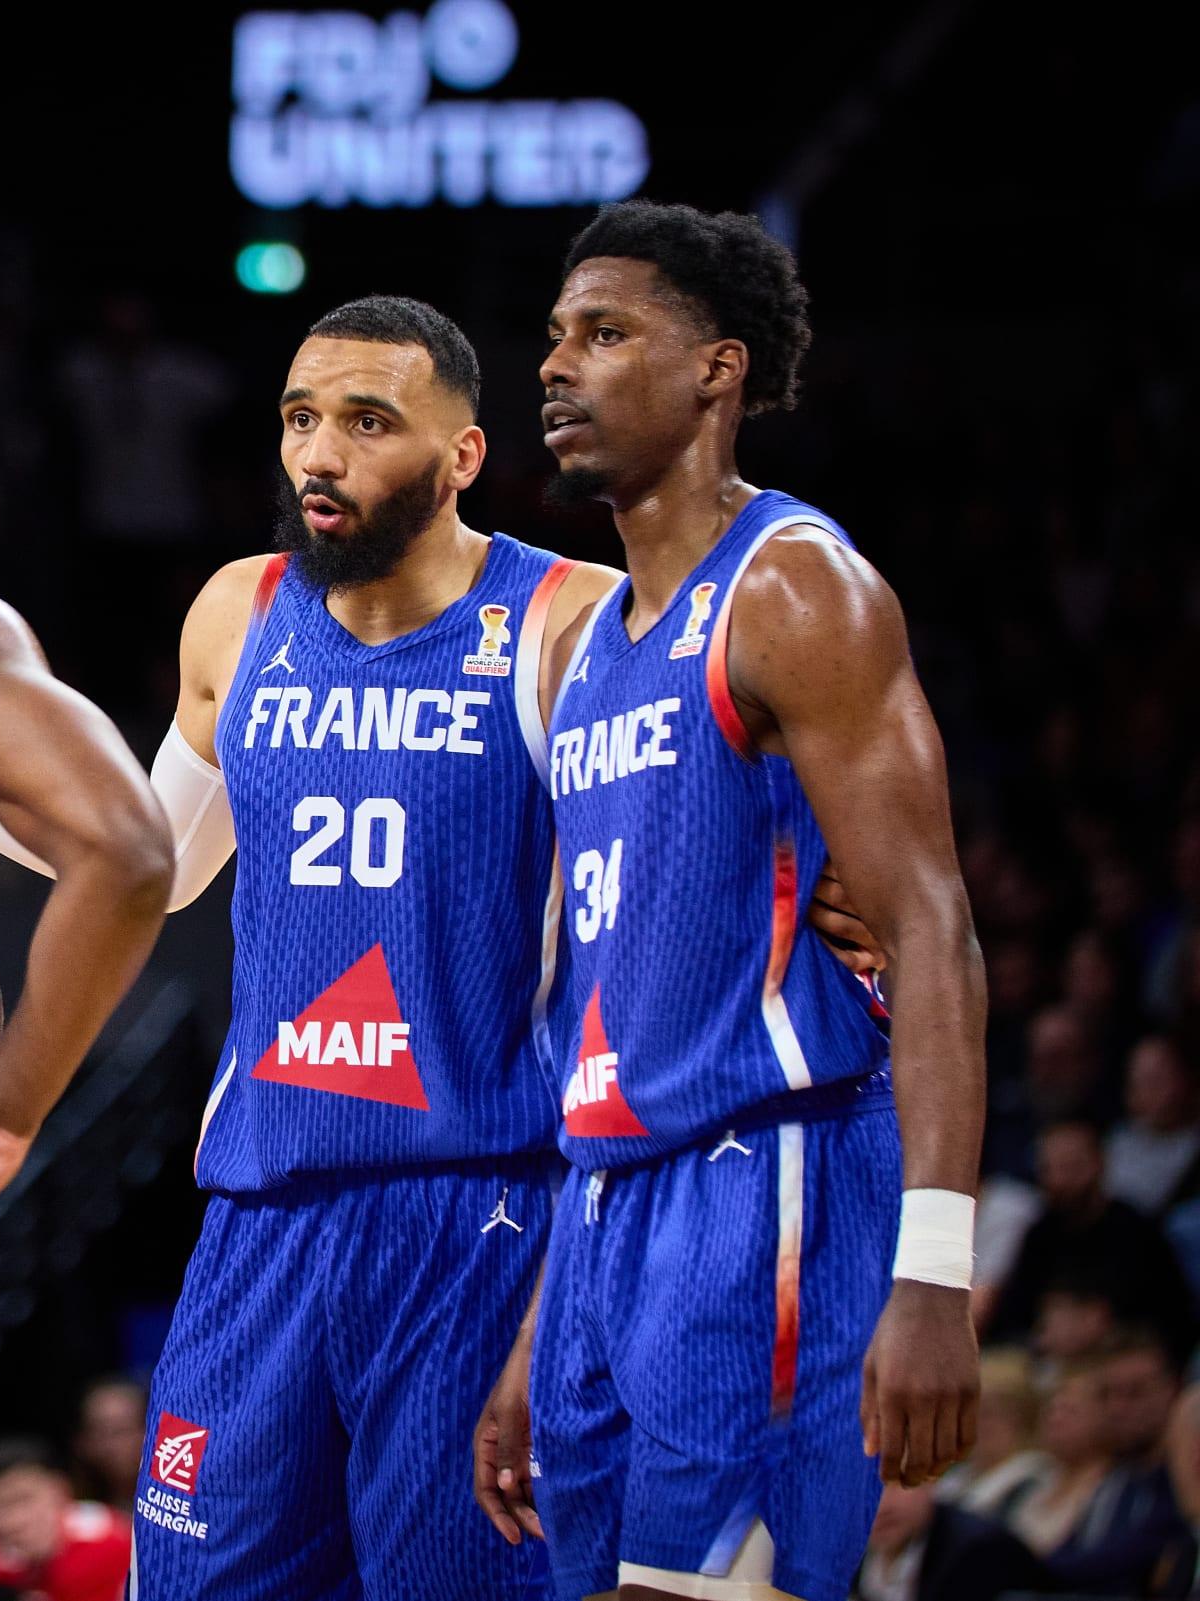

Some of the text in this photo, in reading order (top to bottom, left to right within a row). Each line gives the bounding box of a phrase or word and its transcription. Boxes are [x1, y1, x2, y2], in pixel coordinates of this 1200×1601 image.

[230, 98, 650, 208] UNITED
[465, 666, 507, 675] QUALIFIERS
[243, 686, 491, 755] FRANCE
[550, 697, 681, 801] FRANCE
[290, 796, 406, 888] 20
[573, 838, 623, 944] 34
[277, 1021, 410, 1067] MAIF
[137, 1497, 208, 1540] D'EPARGNE
[147, 1486, 191, 1516] CAISSE
